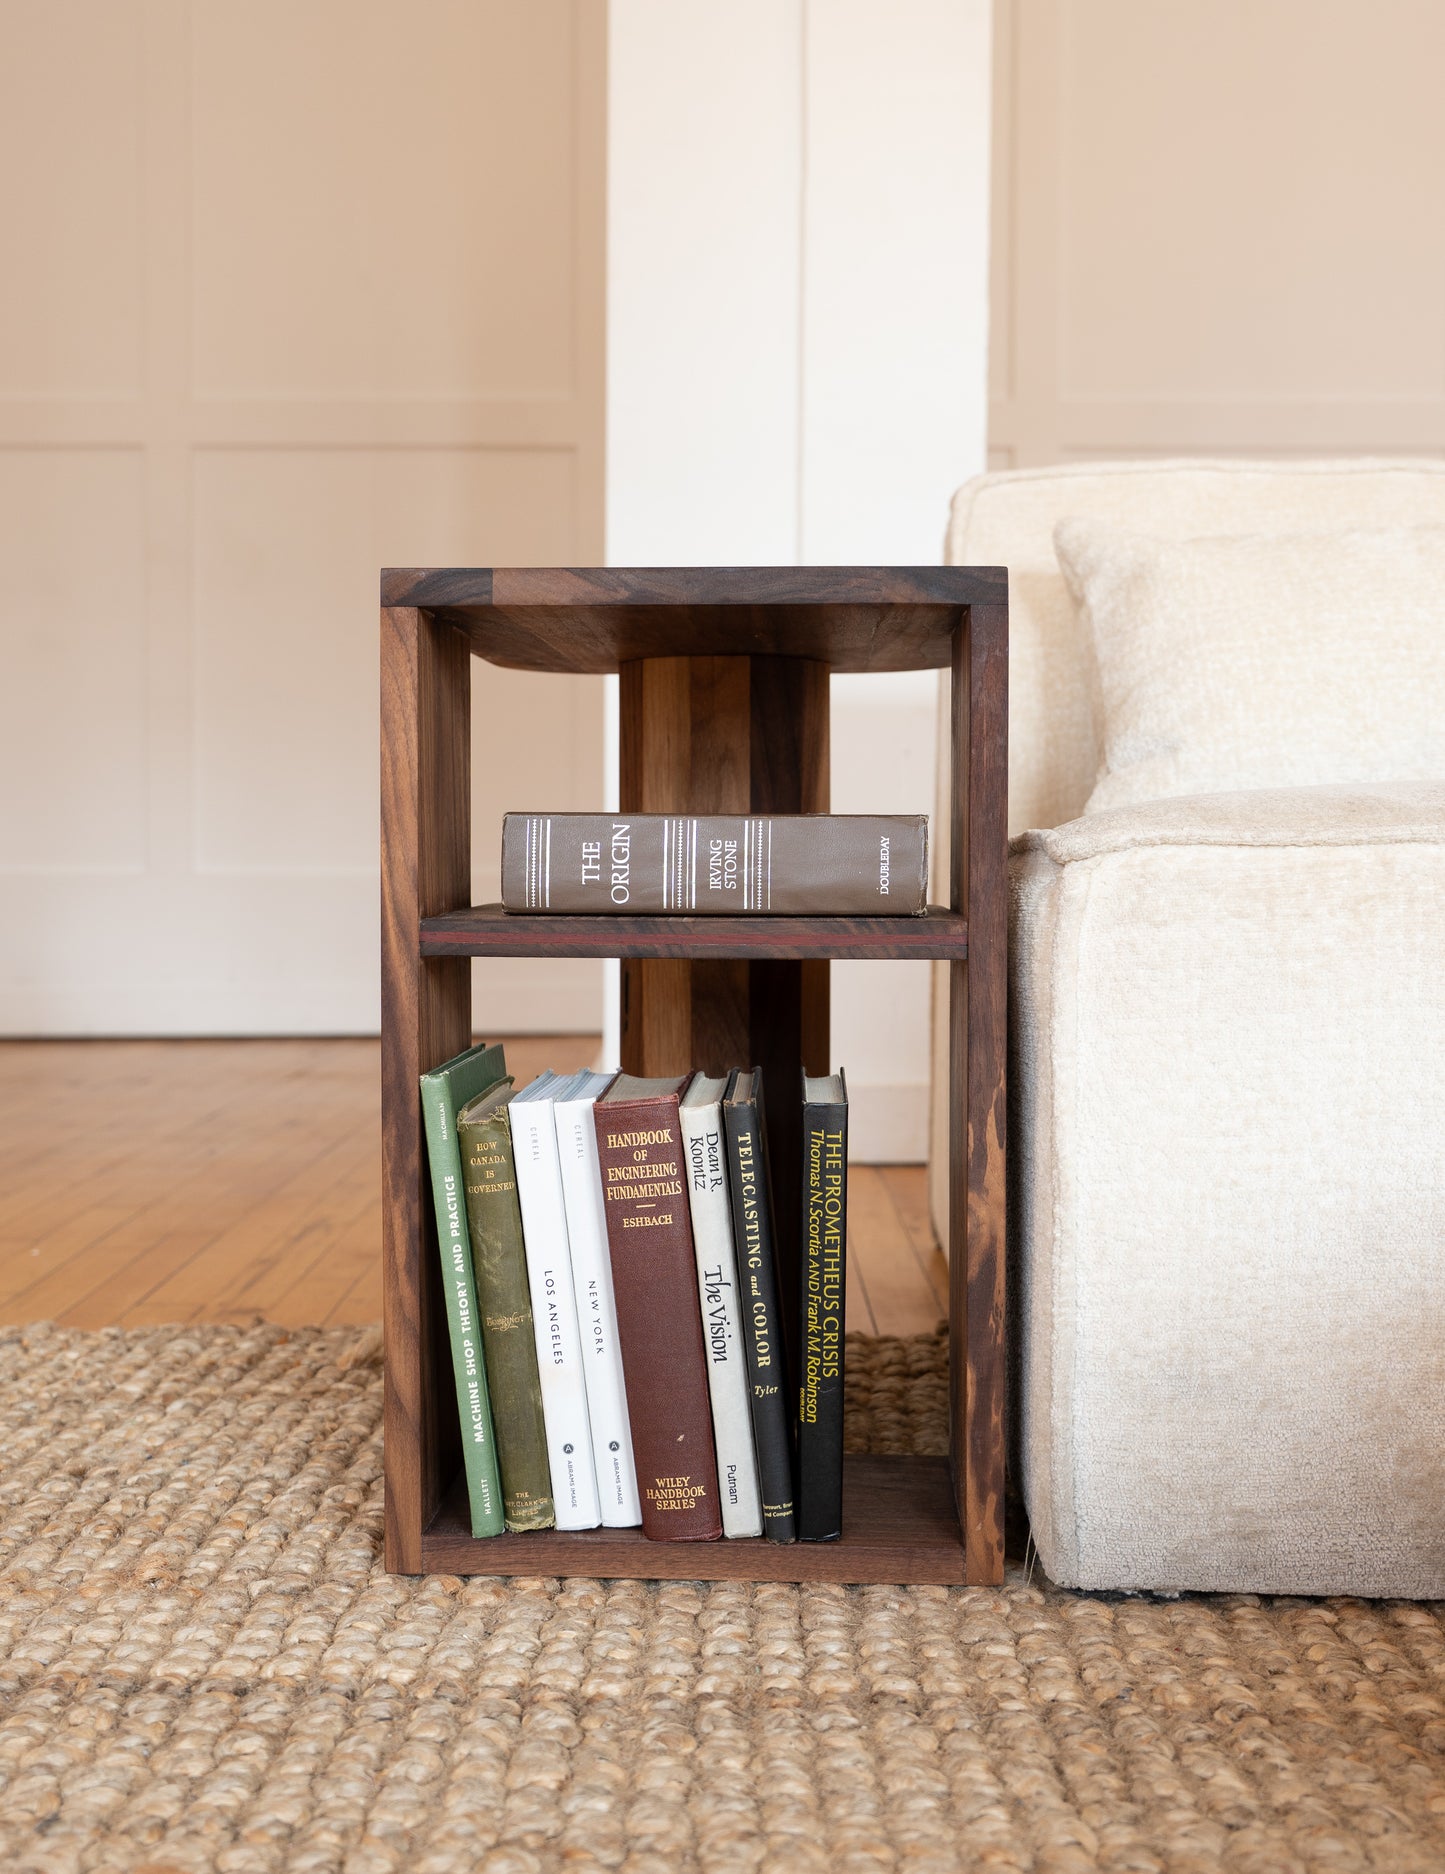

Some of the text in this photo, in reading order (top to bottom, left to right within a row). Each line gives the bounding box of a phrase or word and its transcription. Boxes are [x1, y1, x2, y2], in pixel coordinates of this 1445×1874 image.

[581, 841, 600, 885] THE
[610, 822, 631, 905] ORIGIN
[709, 838, 722, 890] IRVING
[724, 839, 737, 890] STONE
[880, 835, 890, 895] DOUBLEDAY
[438, 1102, 448, 1140] MACMILLAN
[607, 1129, 674, 1149] HANDBOOK
[476, 1141, 497, 1152] HOW
[530, 1126, 540, 1161] CEREAL
[574, 1125, 584, 1159] CEREAL
[633, 1150, 648, 1161] OF
[470, 1155, 506, 1166] CANADA
[485, 1170, 495, 1178] IS
[607, 1162, 677, 1182] ENGINEERING
[690, 1136, 707, 1191] Koontz
[706, 1131, 723, 1192] Dean R.
[468, 1181, 515, 1194] GOVERNED
[606, 1181, 682, 1201] FUNDAMENTALS
[623, 1214, 673, 1228] ESHBACH
[737, 1132, 771, 1368] TELECASTING and COLOR
[822, 1130, 842, 1377] THE PROMETHEUS CRISIS
[806, 1129, 825, 1424] Thomas N. Scortia AND Frank M. Robinson
[444, 1175, 484, 1442] MACHINE SHOP THEORY AND PRACTICE
[544, 1270, 564, 1365] LOS ANGELES
[588, 1280, 605, 1355] NEW YORK
[704, 1264, 732, 1364] The Vision
[754, 1385, 778, 1398] Tyler
[567, 1460, 575, 1487] ABRAMS
[613, 1457, 621, 1484] ABRAMS
[655, 1476, 691, 1488] WILEY
[726, 1464, 738, 1505] Putnam
[480, 1478, 491, 1515] HALLETT
[646, 1485, 706, 1500] HANDBOOK
[656, 1498, 696, 1510] SERIES
